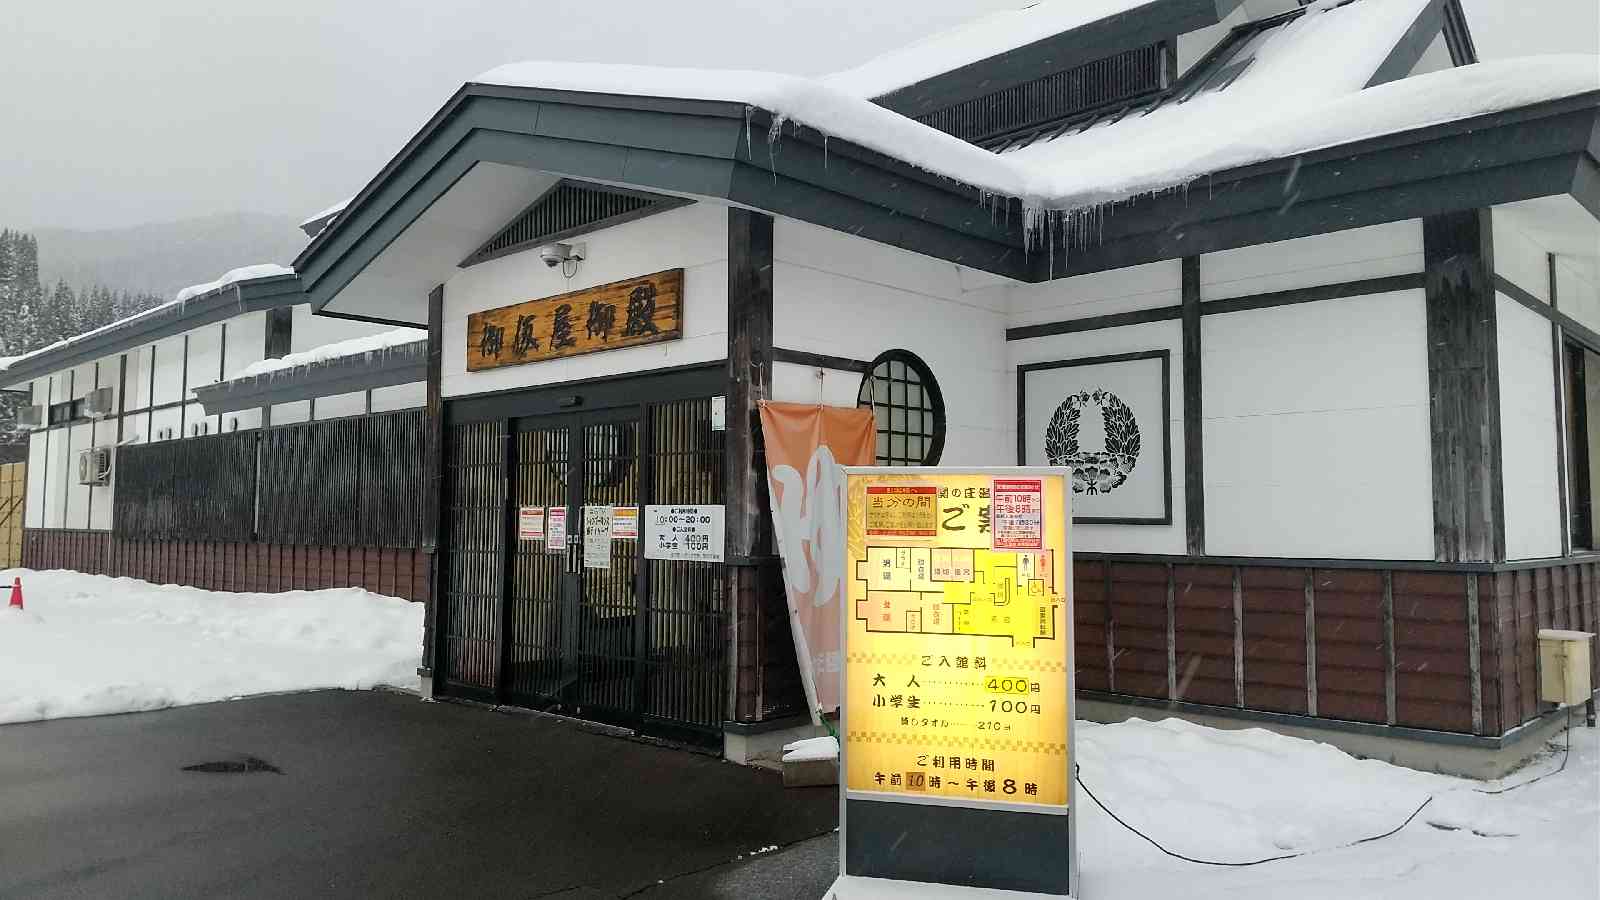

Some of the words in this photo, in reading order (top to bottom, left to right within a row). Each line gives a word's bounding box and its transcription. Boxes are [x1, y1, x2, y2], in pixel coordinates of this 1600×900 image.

[872, 496, 931, 508] 当分の間
[921, 655, 987, 670] ご入館料
[987, 679, 1041, 692] 400円
[872, 694, 921, 709] 小学生
[989, 700, 1041, 714] 100円
[916, 754, 995, 771] ご利用時間
